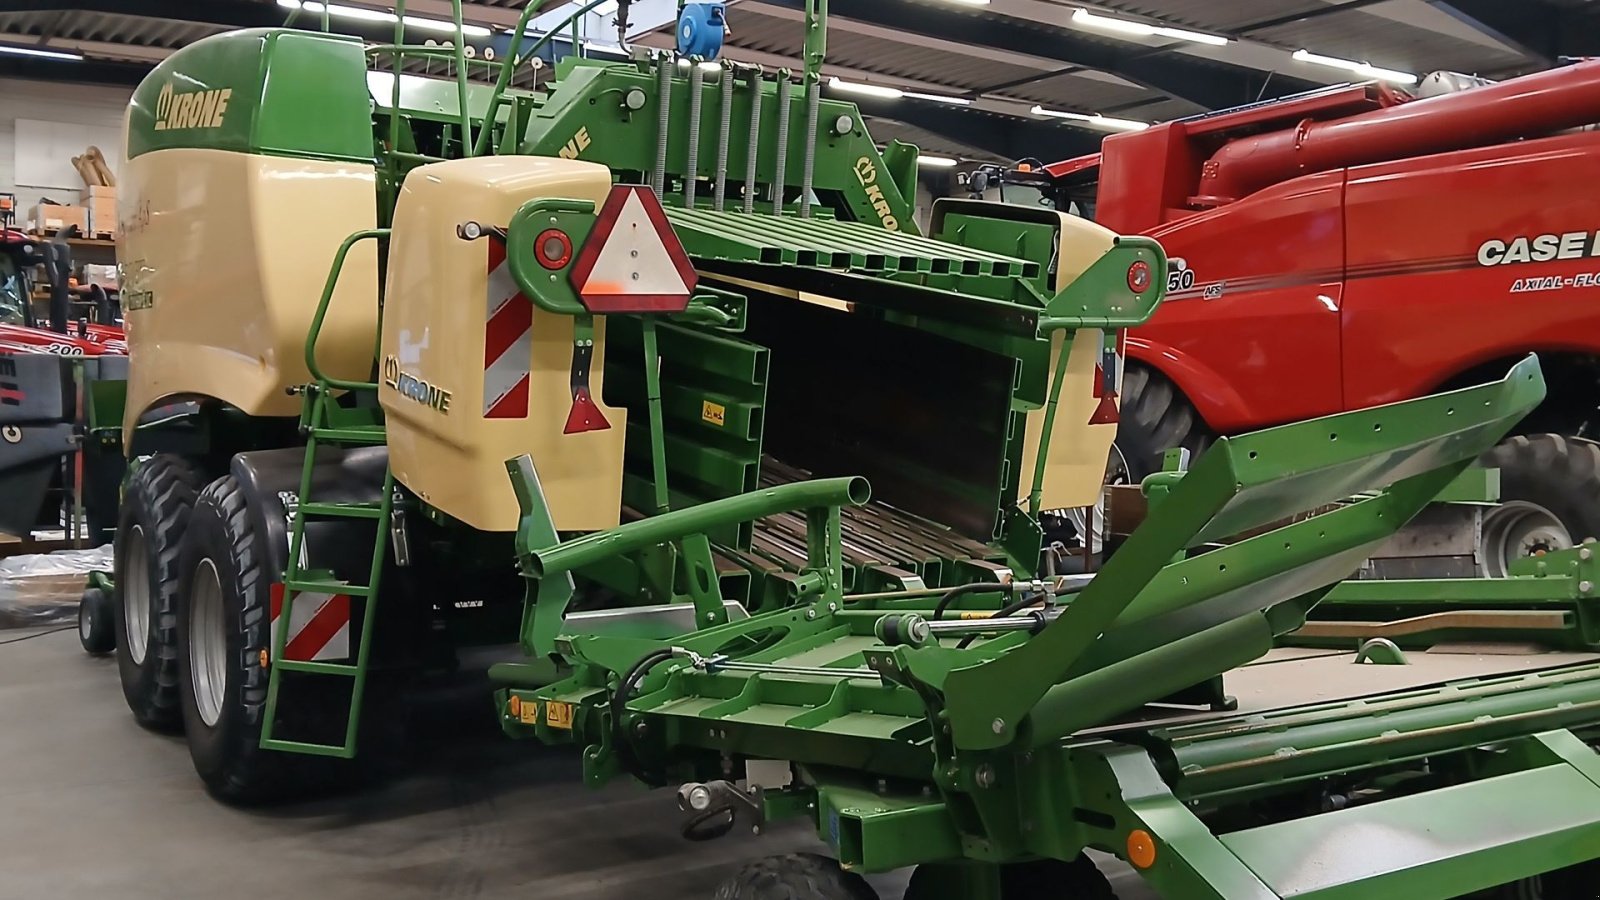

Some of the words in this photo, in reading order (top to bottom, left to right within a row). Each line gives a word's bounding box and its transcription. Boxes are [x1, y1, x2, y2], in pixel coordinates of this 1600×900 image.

[166, 88, 233, 130] KRONE
[1477, 231, 1588, 266] CASE
[1166, 269, 1195, 292] 50
[48, 342, 84, 357] 200
[398, 370, 453, 416] KRONE
